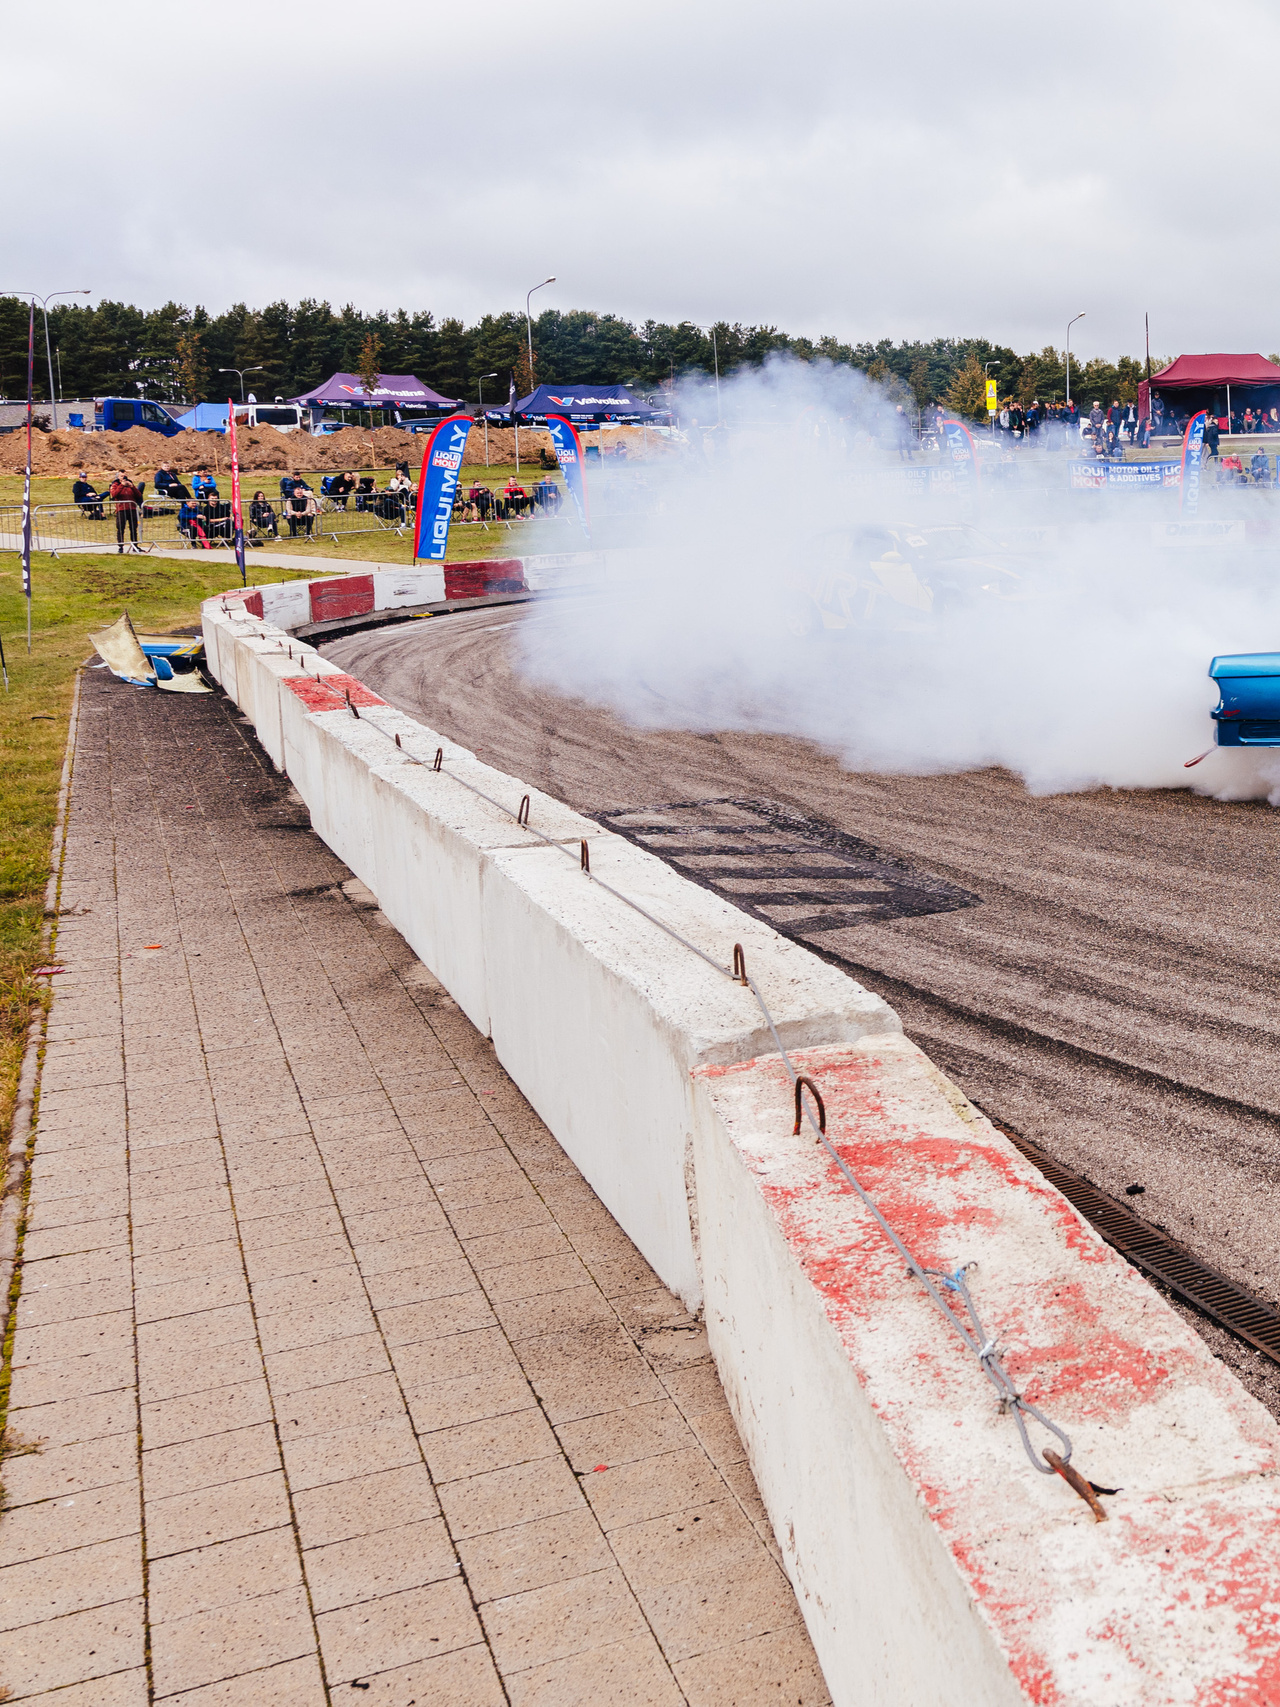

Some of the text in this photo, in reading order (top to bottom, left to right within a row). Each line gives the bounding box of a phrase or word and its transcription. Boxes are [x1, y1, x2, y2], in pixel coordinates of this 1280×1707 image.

[367, 387, 426, 397] Valvoline
[574, 398, 630, 406] Valvoline
[435, 451, 459, 461] LIQUI
[433, 458, 458, 469] MOLY
[1072, 466, 1105, 476] LIQUI
[1109, 465, 1160, 474] MOTOR OILS
[1164, 465, 1182, 475] LIQ
[1072, 476, 1106, 488] MOLY
[1109, 473, 1161, 482] & ADDITIVES
[1164, 477, 1182, 487] MO
[1187, 471, 1199, 514] LIQUI
[430, 496, 453, 560] LIQUI
